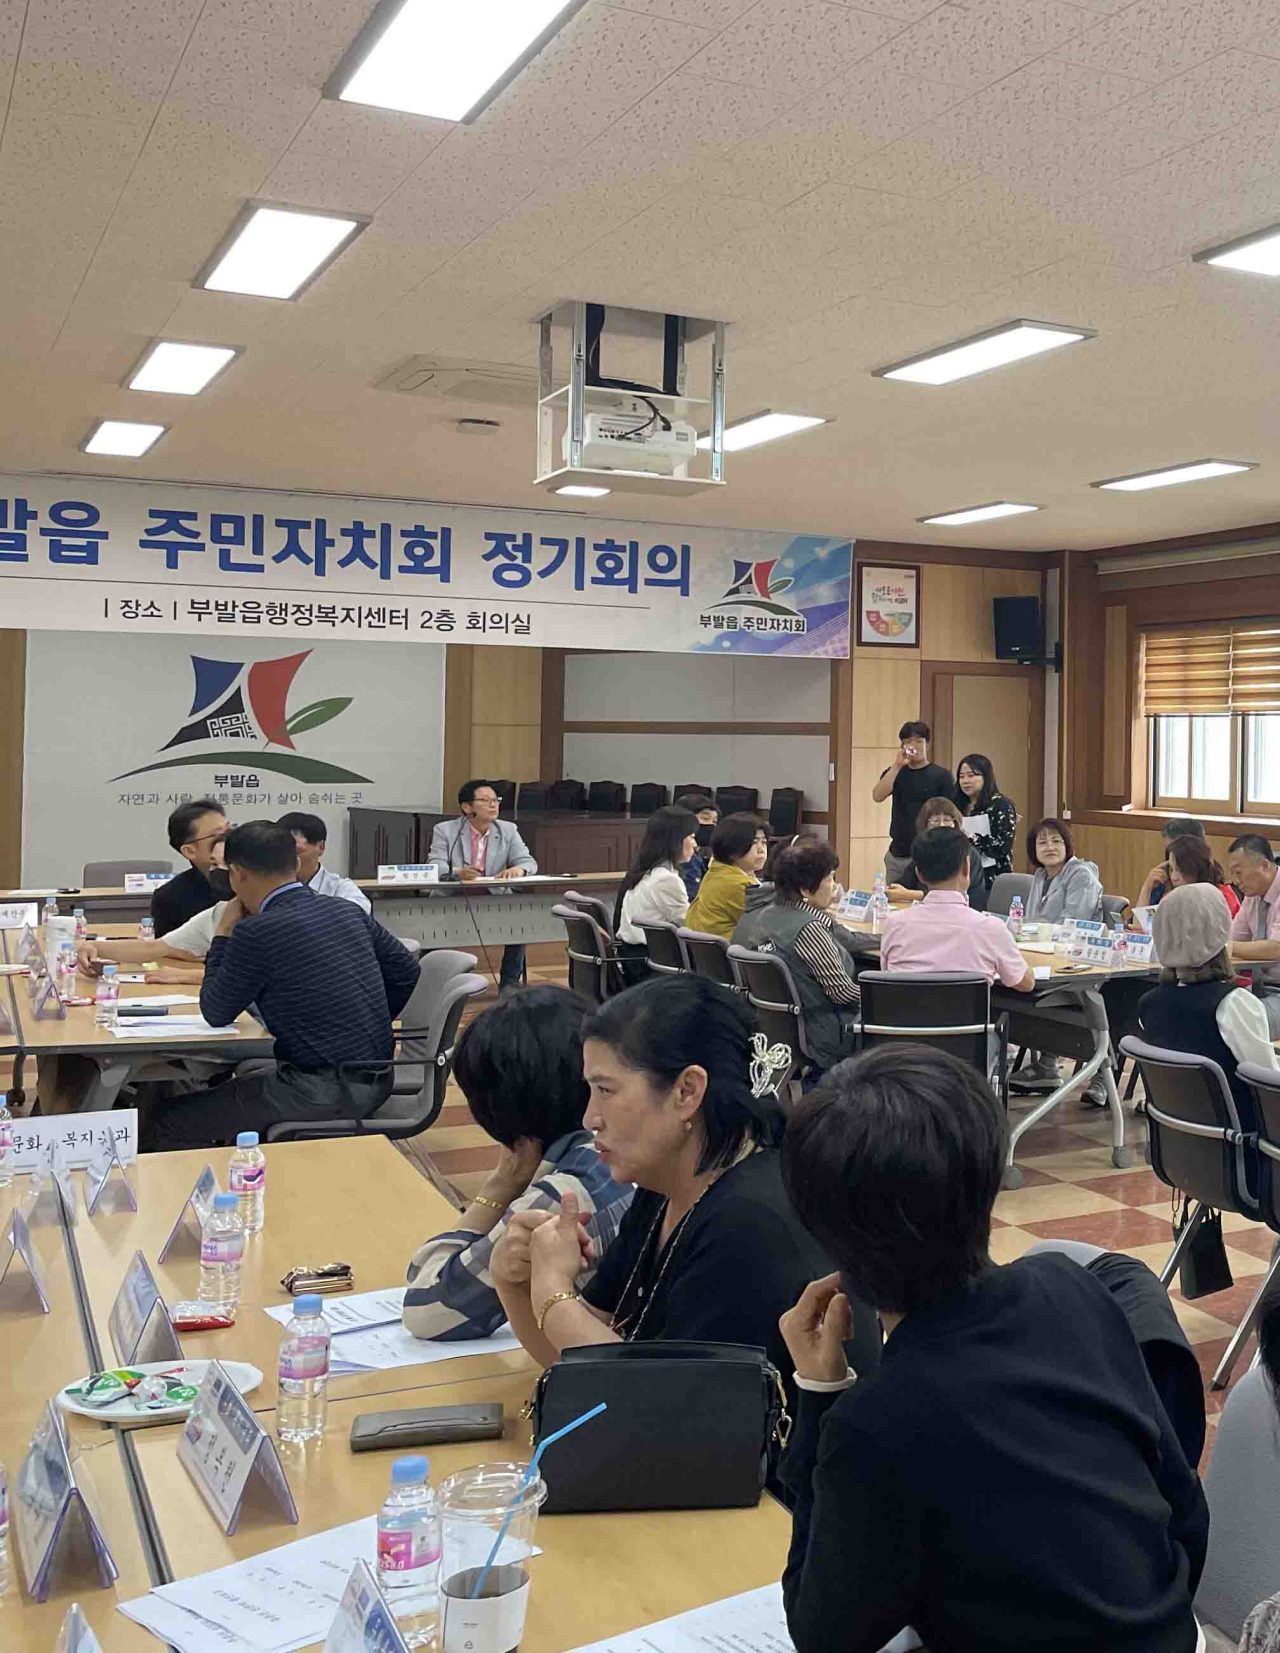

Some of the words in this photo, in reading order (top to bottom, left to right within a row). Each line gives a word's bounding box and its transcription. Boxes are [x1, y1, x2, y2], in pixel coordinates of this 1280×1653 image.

[138, 508, 452, 583] 주민자치회
[481, 530, 691, 598] 정기회의
[119, 599, 164, 619] 장소
[187, 598, 410, 631] 부발읍행정복지센터
[420, 611, 457, 633] 2층
[466, 611, 532, 636] 회의실
[699, 614, 738, 630] 부발읍
[742, 616, 805, 632] 주민자치회
[214, 774, 260, 788] 부발읍
[118, 793, 160, 806] 자연과
